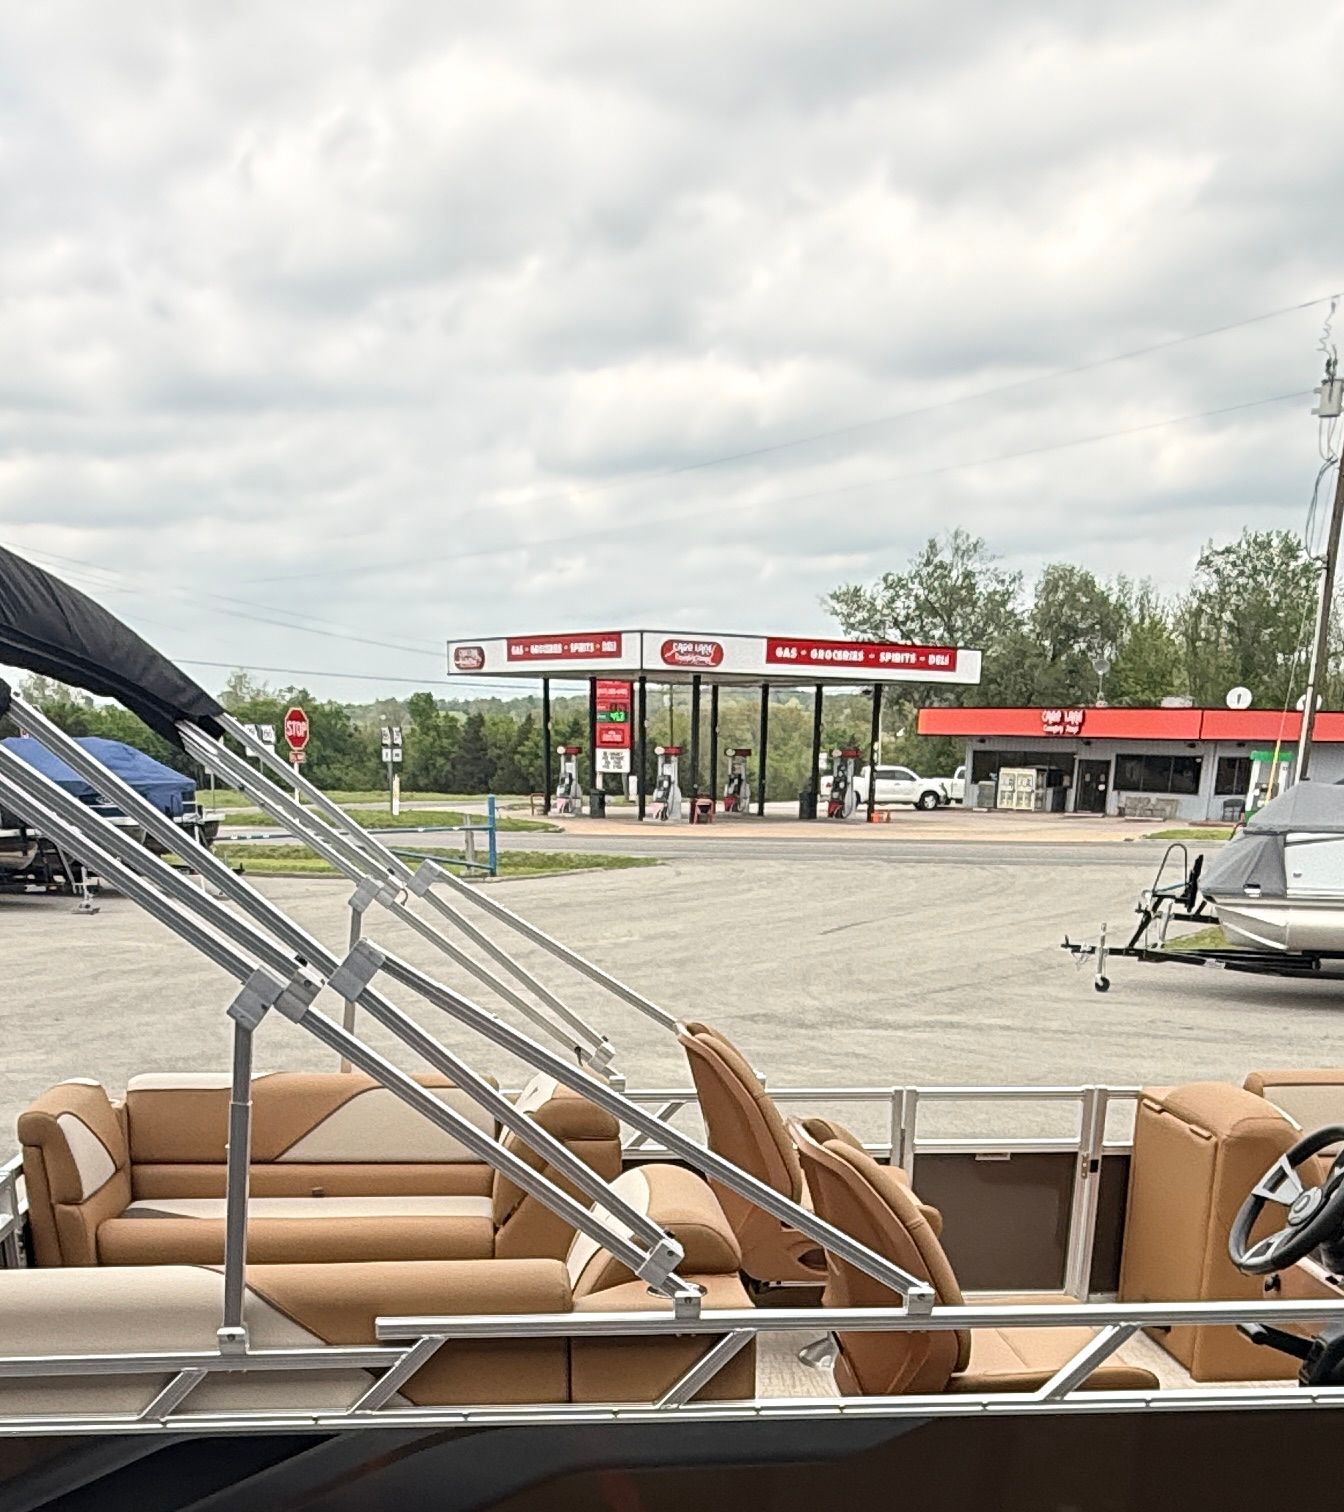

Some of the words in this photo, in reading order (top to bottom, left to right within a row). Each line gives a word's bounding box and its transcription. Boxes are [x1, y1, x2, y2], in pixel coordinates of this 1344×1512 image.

[775, 646, 798, 660] GAS
[810, 648, 865, 662] GROCERIES
[879, 651, 916, 664] SPIRITS
[928, 653, 950, 666] DELI
[286, 720, 307, 738] STOP
